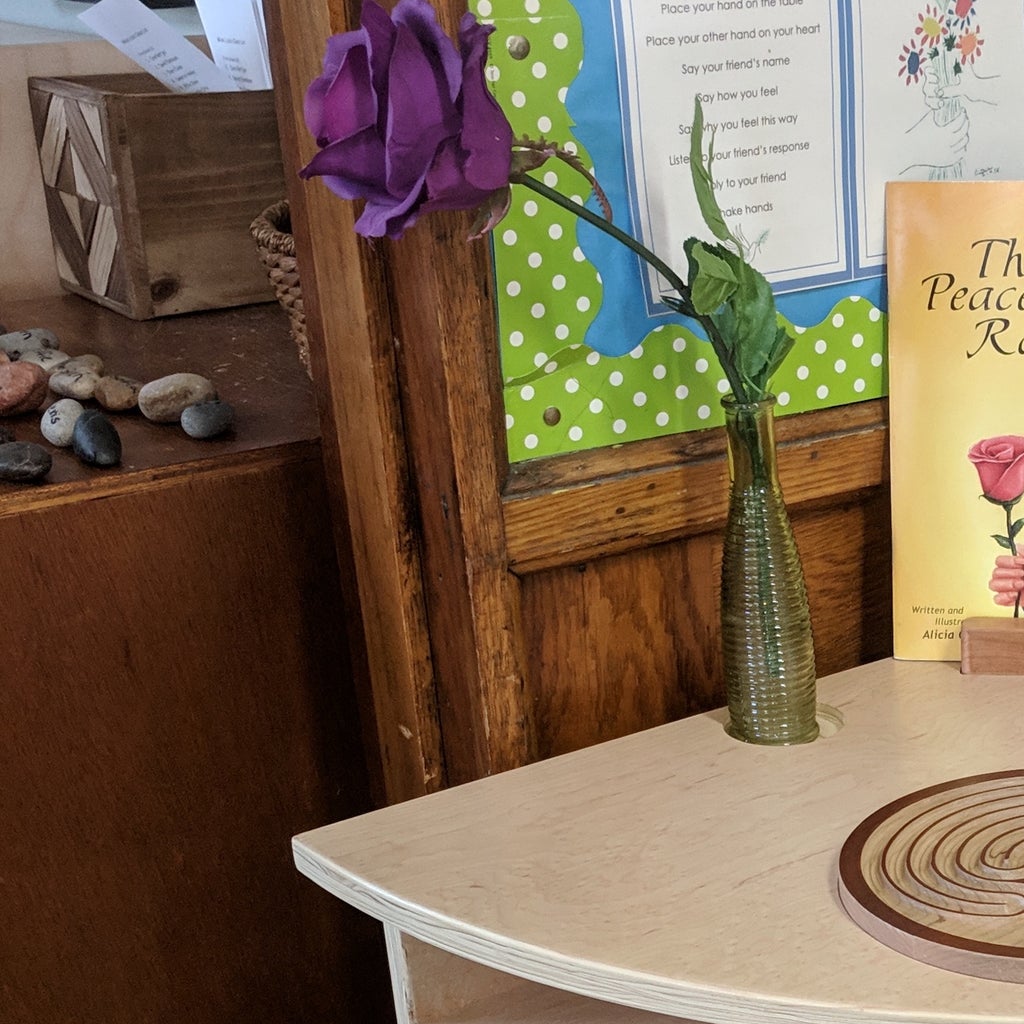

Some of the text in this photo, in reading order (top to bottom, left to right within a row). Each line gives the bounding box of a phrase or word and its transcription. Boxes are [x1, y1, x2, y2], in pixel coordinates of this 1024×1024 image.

[661, 3, 690, 14] Place
[693, 2, 715, 14] your
[717, 0, 743, 10] hand
[746, 0, 758, 8] on
[646, 24, 821, 47] Place your other hand on your heart
[681, 57, 790, 75] Say your friend's name
[697, 86, 778, 104] Say how you feel
[678, 124, 693, 135] Sa
[721, 119, 738, 132] you
[741, 117, 759, 128] feel
[761, 115, 776, 126] this
[778, 114, 798, 125] way
[669, 154, 690, 166] Liste
[733, 145, 767, 158] friend's
[769, 141, 810, 154] response
[726, 178, 736, 188] to
[738, 176, 758, 188] your
[760, 171, 787, 183] friend
[745, 201, 774, 214] hands
[912, 605, 964, 615] Written and
[934, 617, 962, 626] Illustr
[922, 629, 955, 640] Alicia
